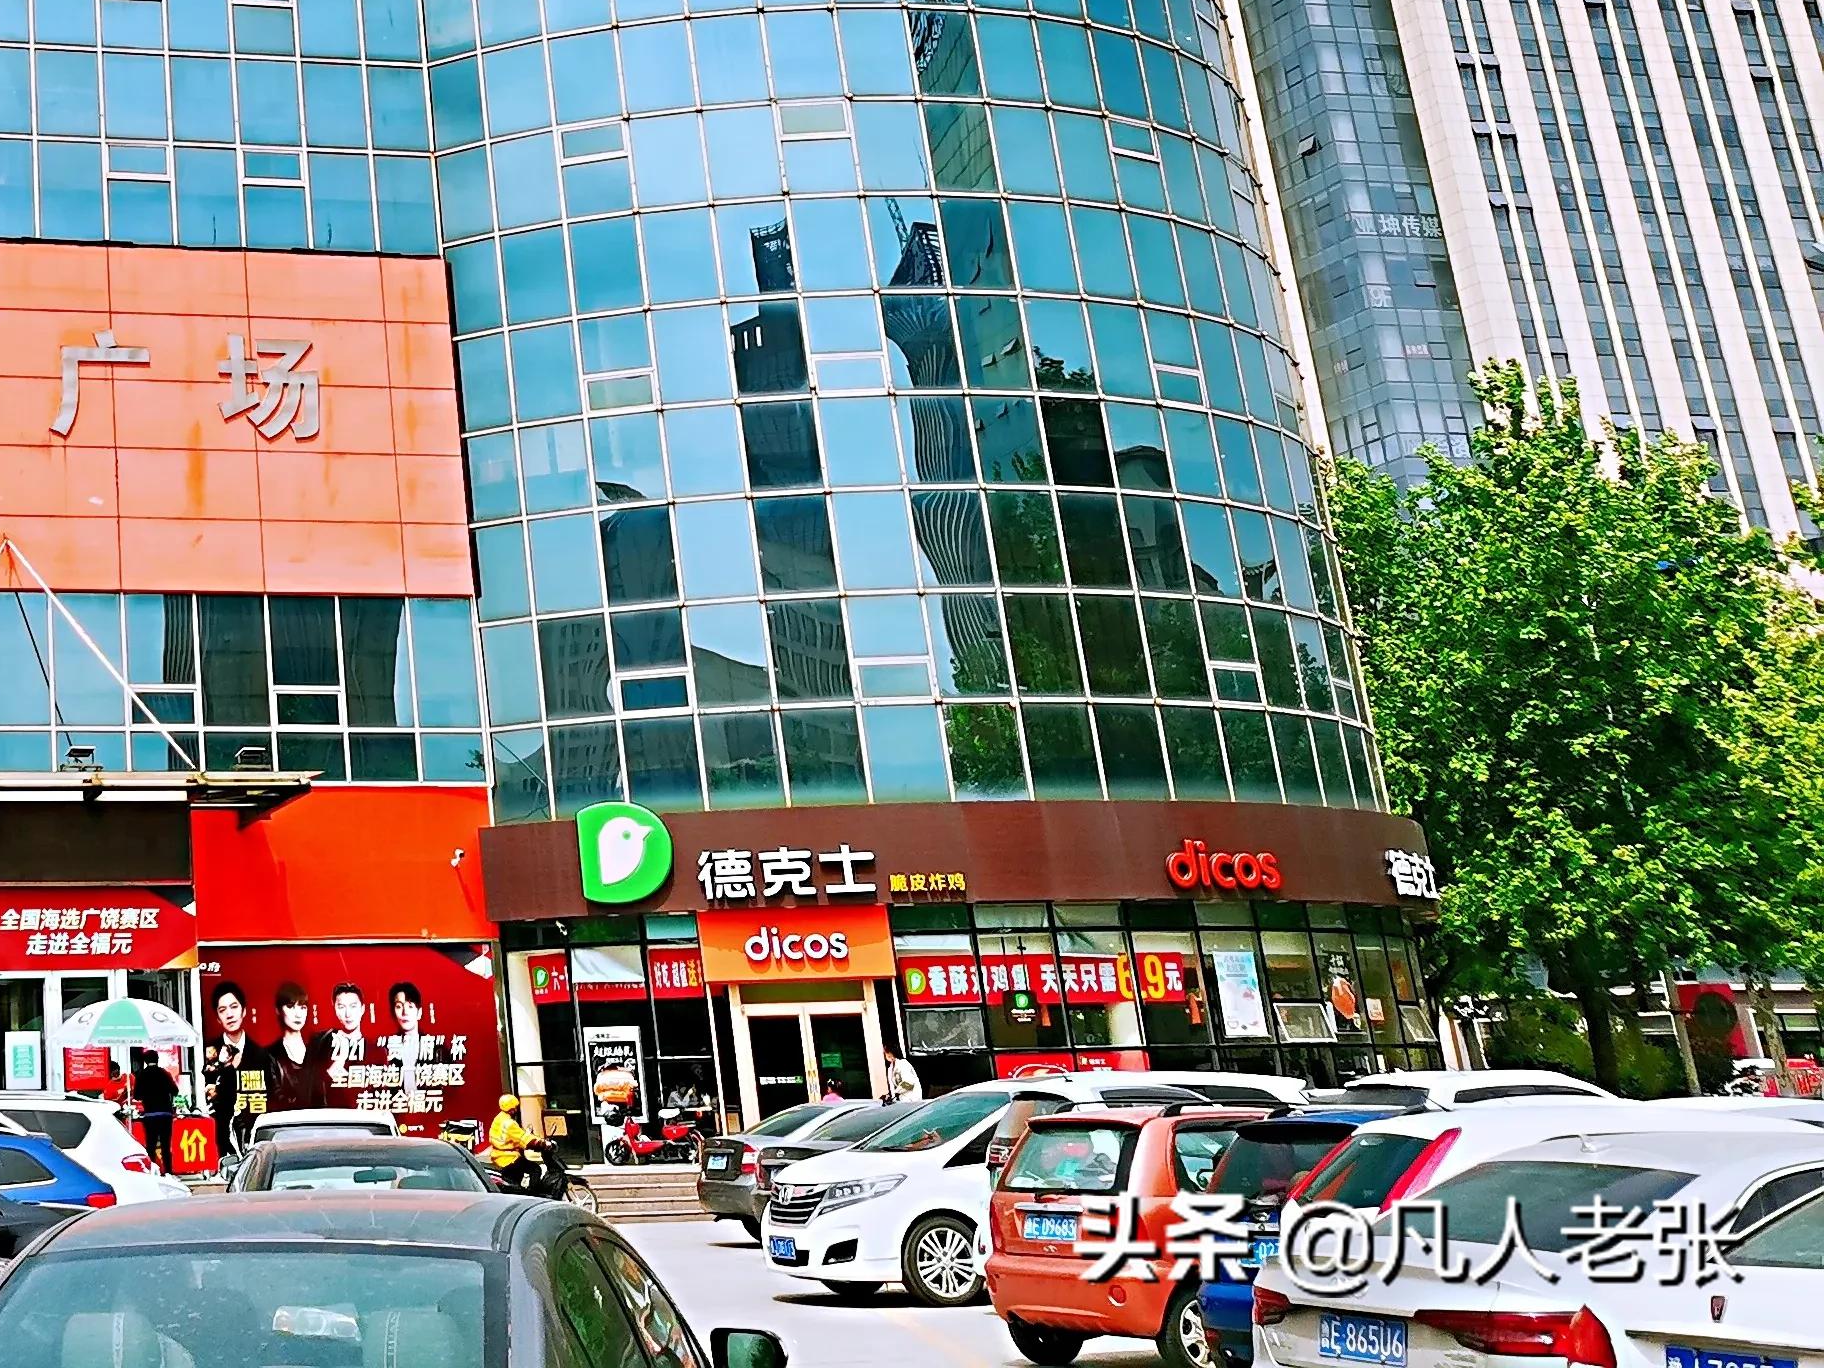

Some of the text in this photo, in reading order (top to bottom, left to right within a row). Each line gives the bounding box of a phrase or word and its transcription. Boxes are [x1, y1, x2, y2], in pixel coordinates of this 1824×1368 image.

[697, 844, 876, 900] 德克士
[1164, 839, 1282, 890] dicos
[889, 872, 966, 893] 脆皮炸鸡
[0, 908, 160, 931] 全国海选广饶赛区
[26, 932, 133, 957] 走进全福元
[744, 926, 850, 962] dicos
[450, 1034, 467, 1061] 杯
[356, 1089, 443, 1114] 走进全福元
[179, 1129, 208, 1163] 价
